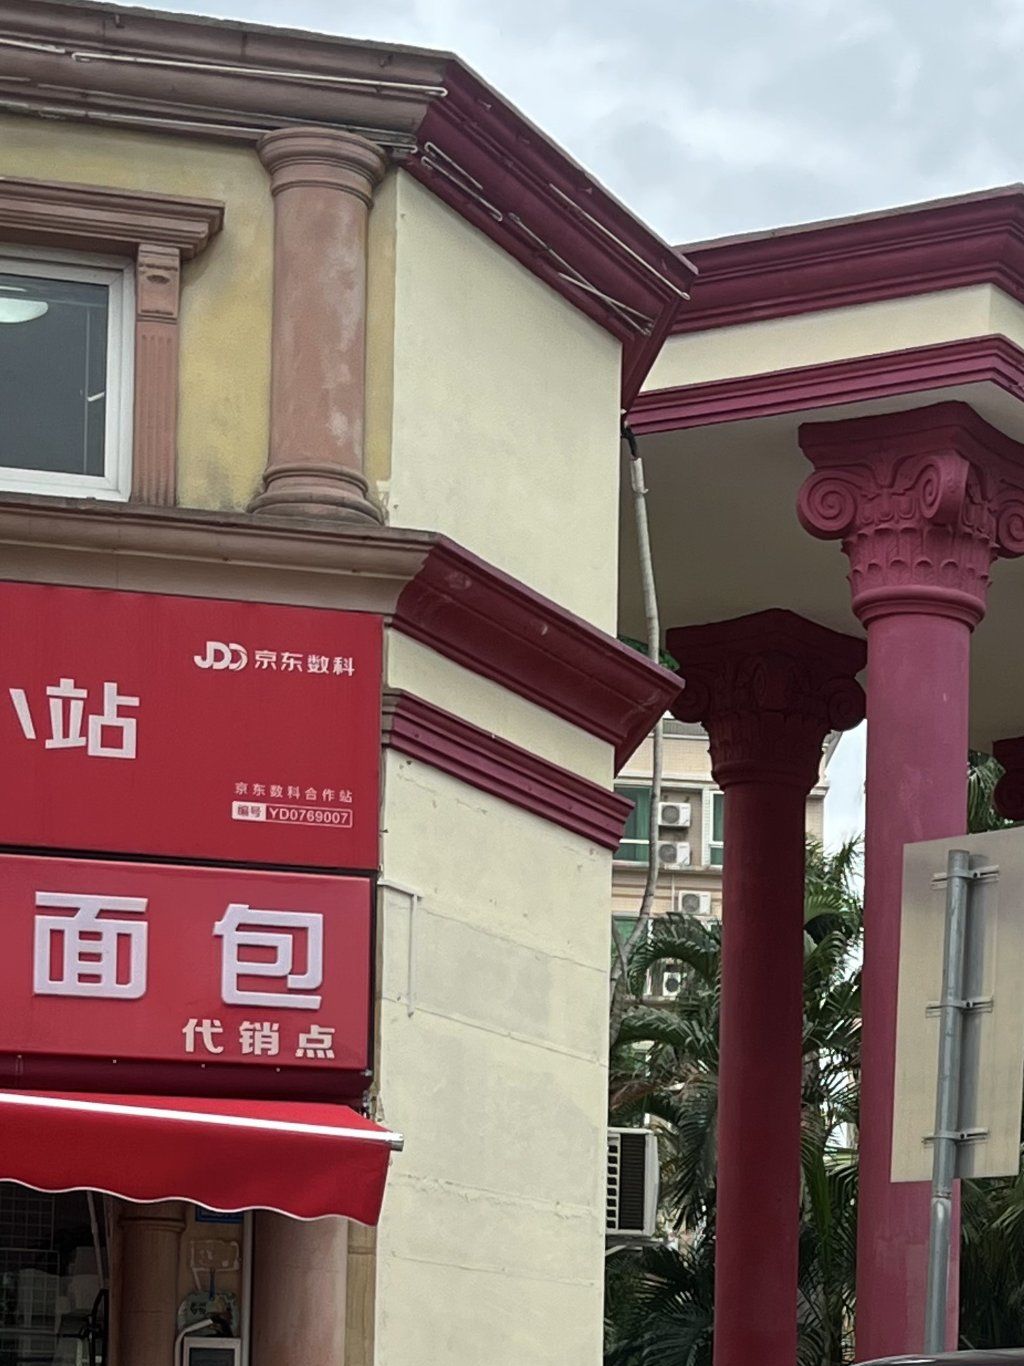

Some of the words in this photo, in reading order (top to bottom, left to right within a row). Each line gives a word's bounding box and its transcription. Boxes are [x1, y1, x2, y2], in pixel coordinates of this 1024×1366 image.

[254, 650, 355, 676] 京东数科
[235, 782, 353, 803] 京东数科合作站
[237, 804, 262, 818] 编号
[269, 807, 348, 824] YD0769007
[34, 891, 325, 1010] 面包
[182, 1019, 336, 1060] 代销点
